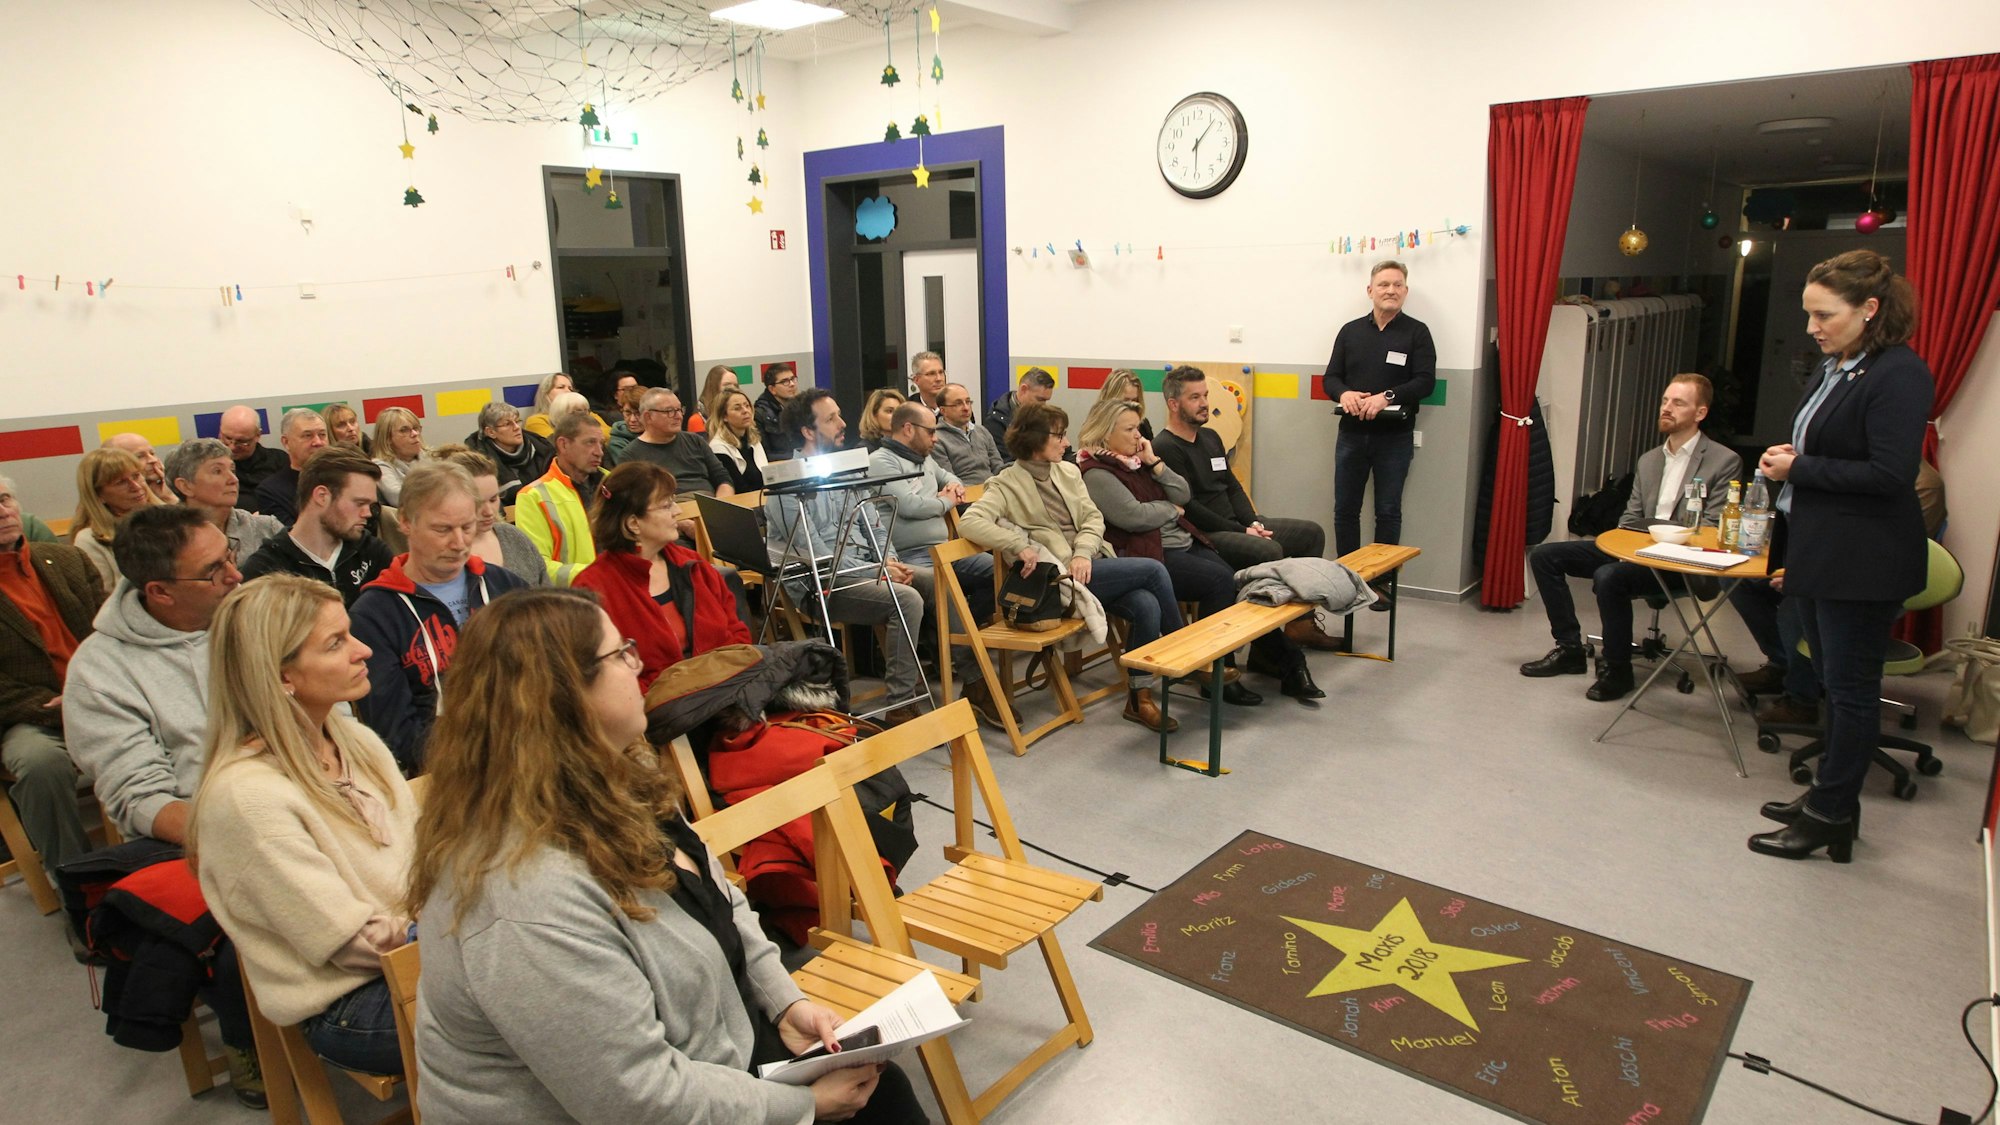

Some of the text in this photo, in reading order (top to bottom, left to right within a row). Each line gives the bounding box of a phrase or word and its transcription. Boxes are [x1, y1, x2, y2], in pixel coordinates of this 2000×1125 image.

[1182, 115, 1190, 127] 11
[1193, 109, 1203, 120] 12
[1216, 121, 1223, 132] 2
[1173, 128, 1183, 139] 10
[1168, 142, 1175, 153] 9
[1216, 152, 1223, 163] 4
[1172, 156, 1179, 167] 8
[1208, 164, 1214, 177] 5
[1193, 168, 1200, 180] 6
[1239, 841, 1285, 856] Lotta
[1213, 862, 1245, 882] Fynn
[1261, 871, 1317, 896] Gideon
[1327, 885, 1348, 912] Marie
[1140, 921, 1161, 953] Emilia
[1180, 914, 1237, 937] Moritz
[1470, 920, 1522, 938] Oskar
[1281, 931, 1301, 976] Tamino
[1355, 933, 1406, 972] Maxis
[1543, 935, 1576, 968] Jacob
[1210, 951, 1237, 983] Franz
[1396, 947, 1440, 981] 2018
[1604, 947, 1650, 996] Vincent
[1488, 980, 1508, 1012] Leon
[1531, 976, 1582, 1005] Jasmin
[1667, 966, 1719, 1007] Simon
[1369, 995, 1406, 1014] Kim
[1338, 996, 1361, 1038] Jonah
[1644, 1012, 1699, 1032] Finja
[1390, 1031, 1478, 1052] Manuel
[1473, 1059, 1508, 1086] Eric
[1612, 1036, 1641, 1088] Jaschi
[1548, 1057, 1584, 1108] Anton
